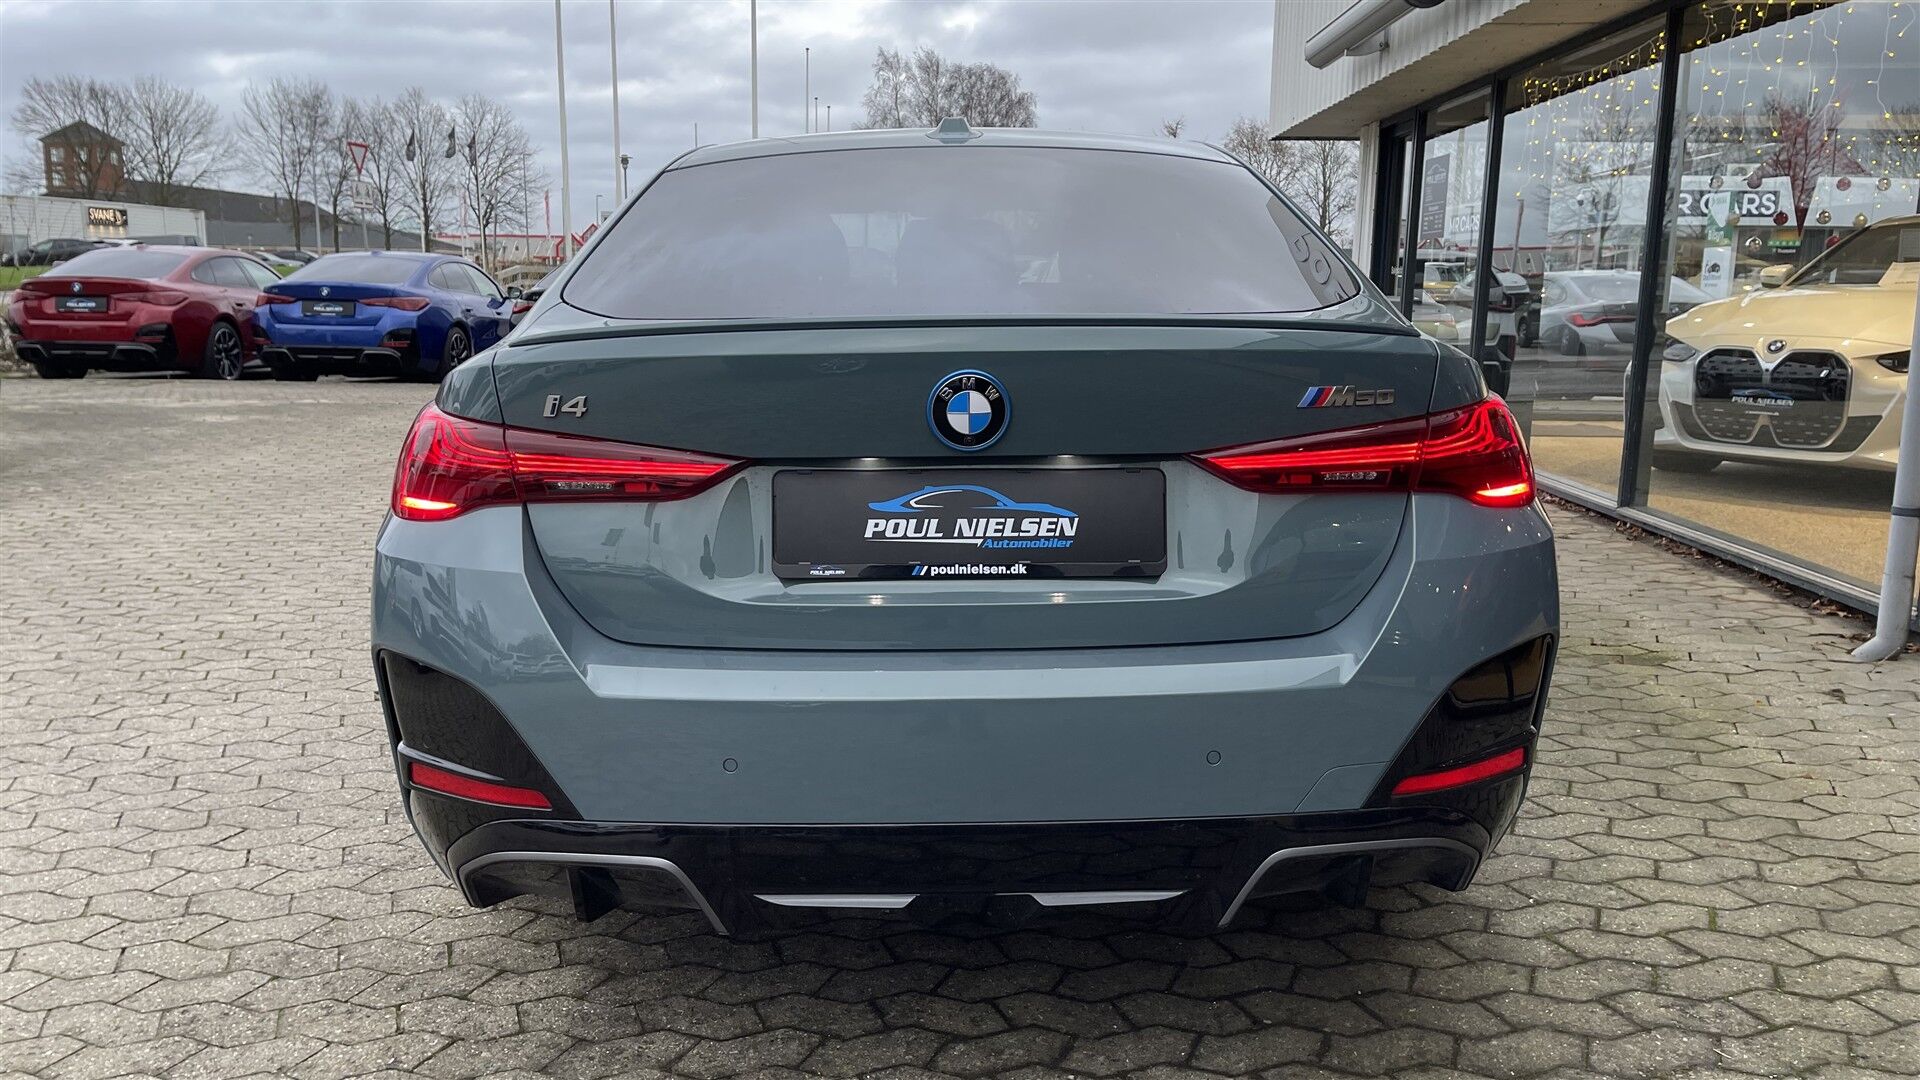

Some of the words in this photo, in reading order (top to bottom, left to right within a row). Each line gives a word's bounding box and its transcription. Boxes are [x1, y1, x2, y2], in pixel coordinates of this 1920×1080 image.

[1700, 192, 1776, 215] CRS
[90, 208, 115, 221] SVANE
[939, 377, 1000, 401] BMW
[543, 394, 588, 418] i4
[864, 518, 944, 538] POUL
[953, 517, 1080, 538] NIELSEN
[982, 539, 1074, 549] Automobiler
[930, 564, 1028, 577] poulnielsen.dk
